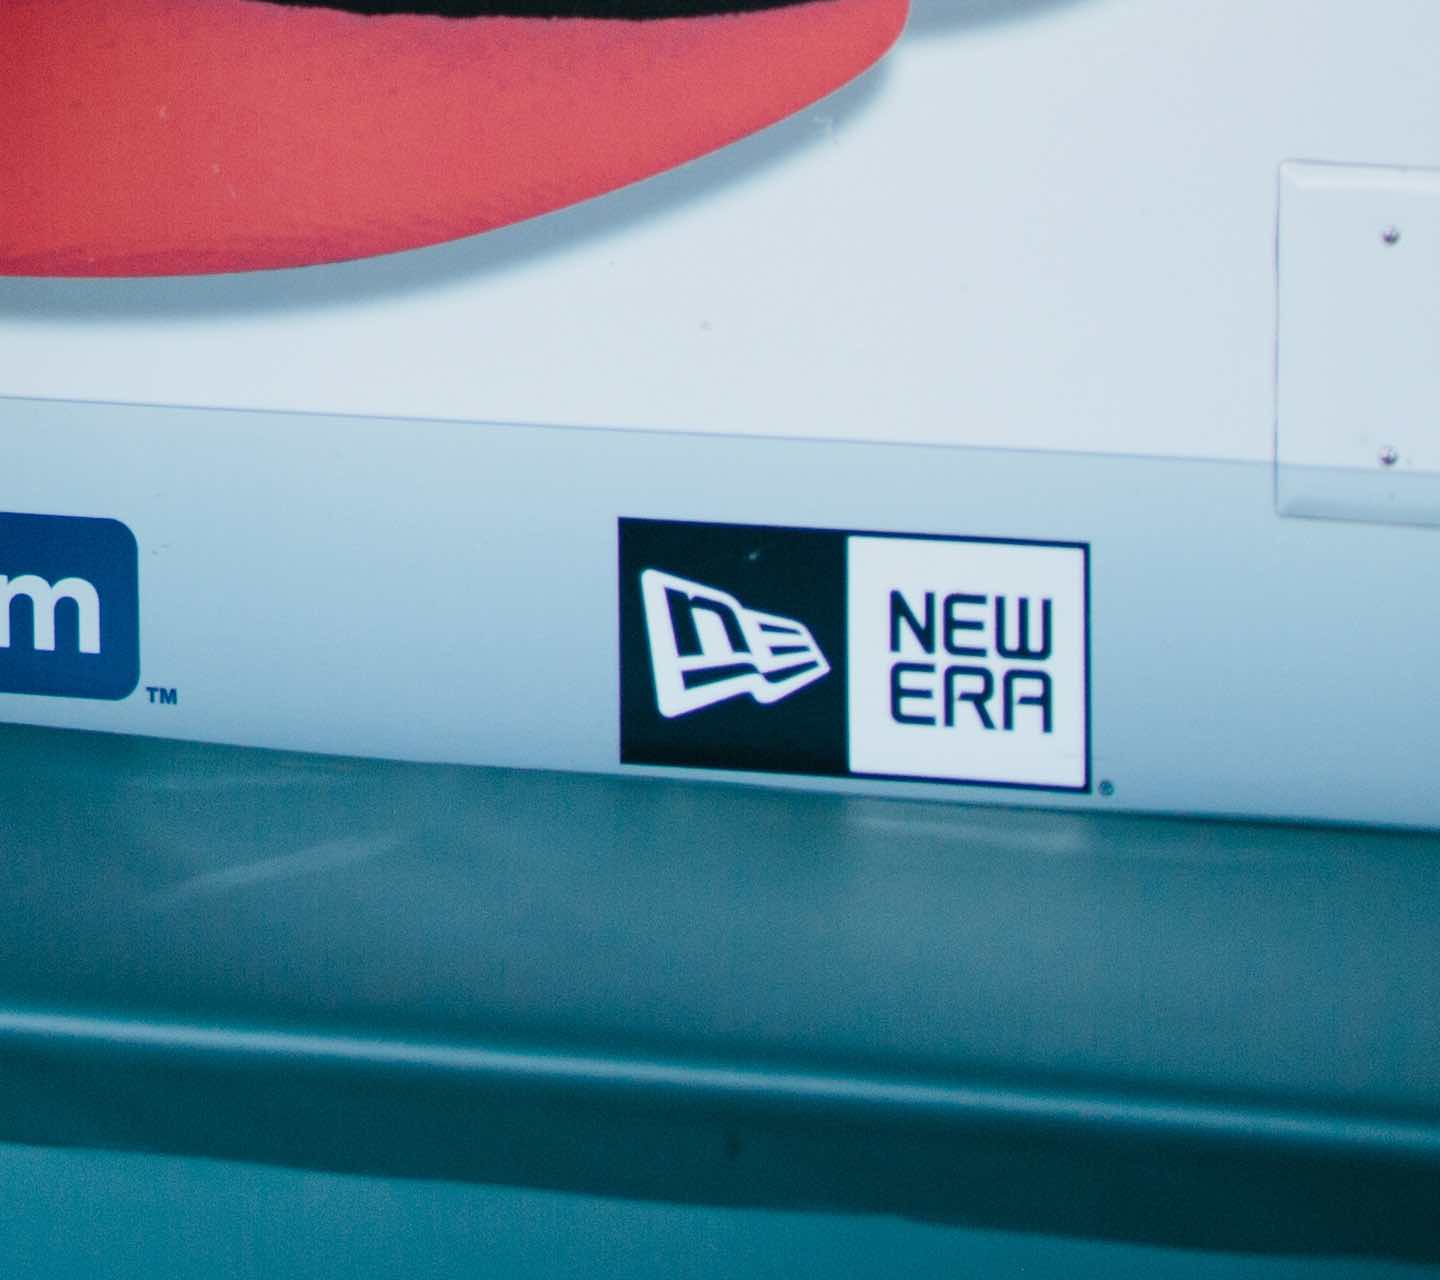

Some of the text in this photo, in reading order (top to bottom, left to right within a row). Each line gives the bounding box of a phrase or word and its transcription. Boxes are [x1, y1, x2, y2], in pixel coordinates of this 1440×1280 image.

[889, 589, 1053, 661] NEW
[145, 685, 178, 705] TM
[889, 662, 1054, 735] ERA
